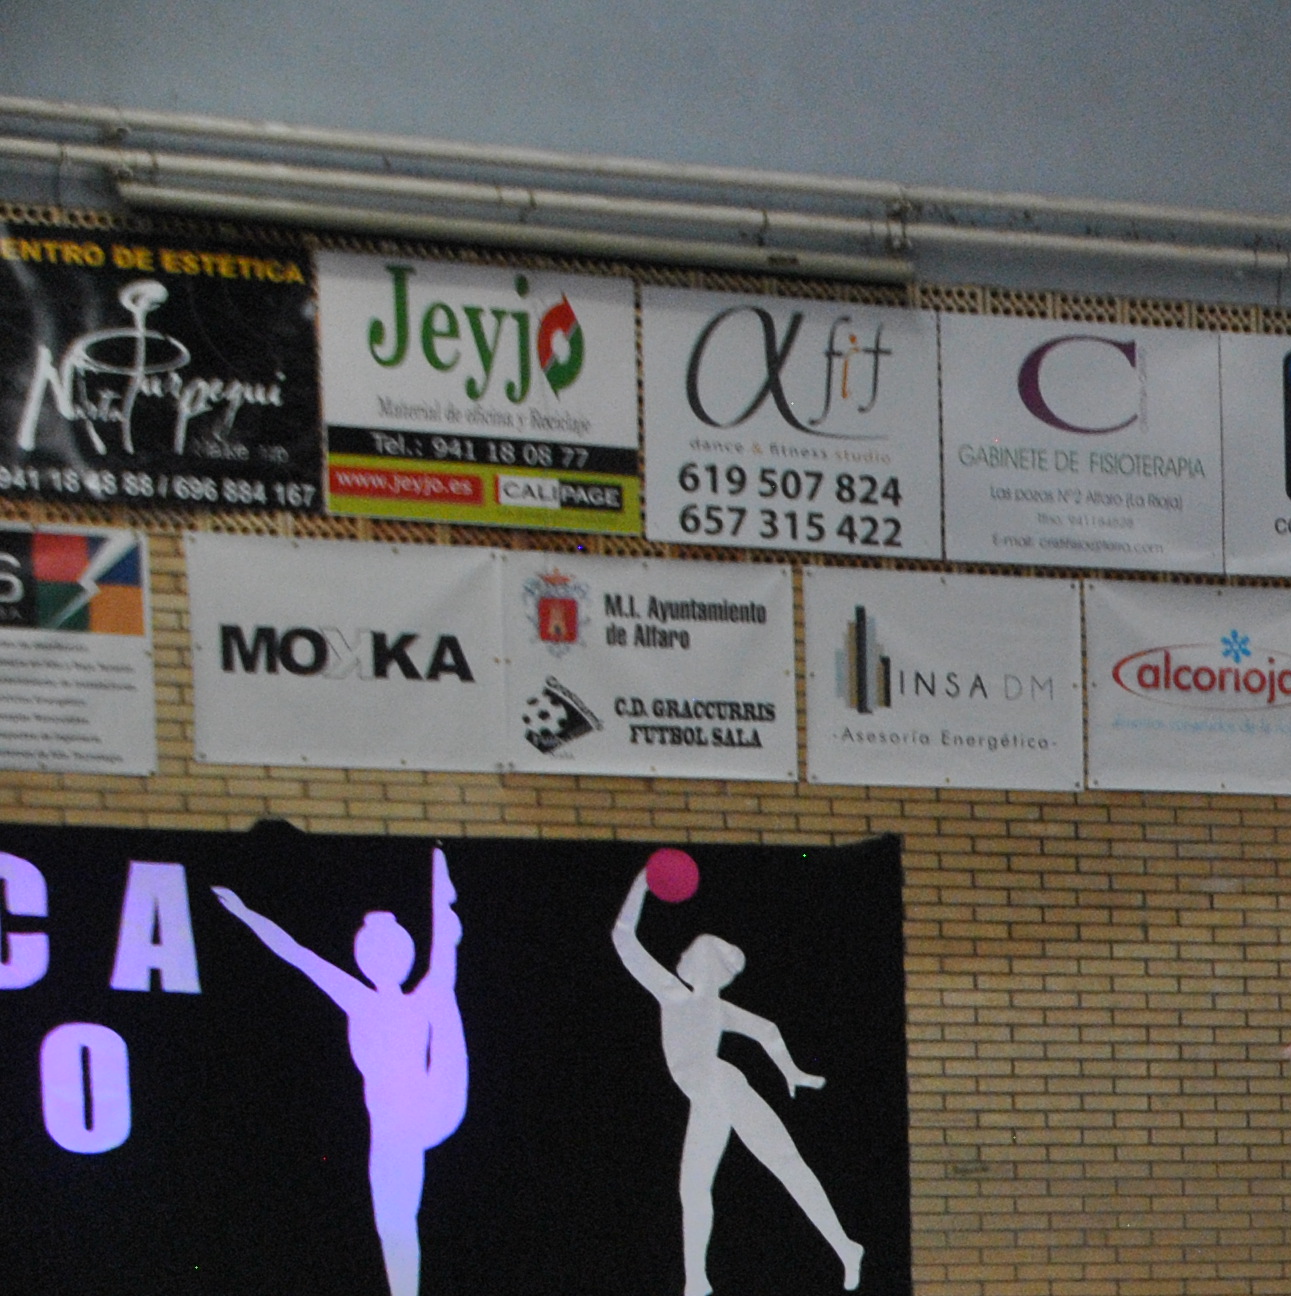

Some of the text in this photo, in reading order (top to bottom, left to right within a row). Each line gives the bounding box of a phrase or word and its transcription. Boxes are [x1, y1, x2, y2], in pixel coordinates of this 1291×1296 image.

[111, 243, 155, 272] DE
[368, 263, 585, 403] Jeyjo
[1018, 334, 1138, 435] C
[445, 404, 463, 425] de
[515, 414, 524, 432] y
[432, 438, 476, 462] 941
[488, 441, 516, 464] 18
[523, 444, 552, 467] 08
[561, 447, 589, 469] 77
[689, 436, 745, 453] dance
[769, 444, 828, 460] fitness
[834, 448, 892, 466] studio
[958, 443, 1206, 479] GABINETE DE FISIOTERAPIA
[171, 474, 219, 502] 696
[274, 481, 316, 508] 167
[334, 470, 473, 497] www.jeyjo.es
[678, 462, 902, 507] 619 507 824
[679, 503, 902, 549] 657 315 422
[604, 594, 767, 624] M.I. Ayuntamiento
[606, 622, 690, 650] de Alfaro
[614, 696, 776, 722] C.D. GRACCURRIS
[630, 724, 762, 748] FUTBOL SALA
